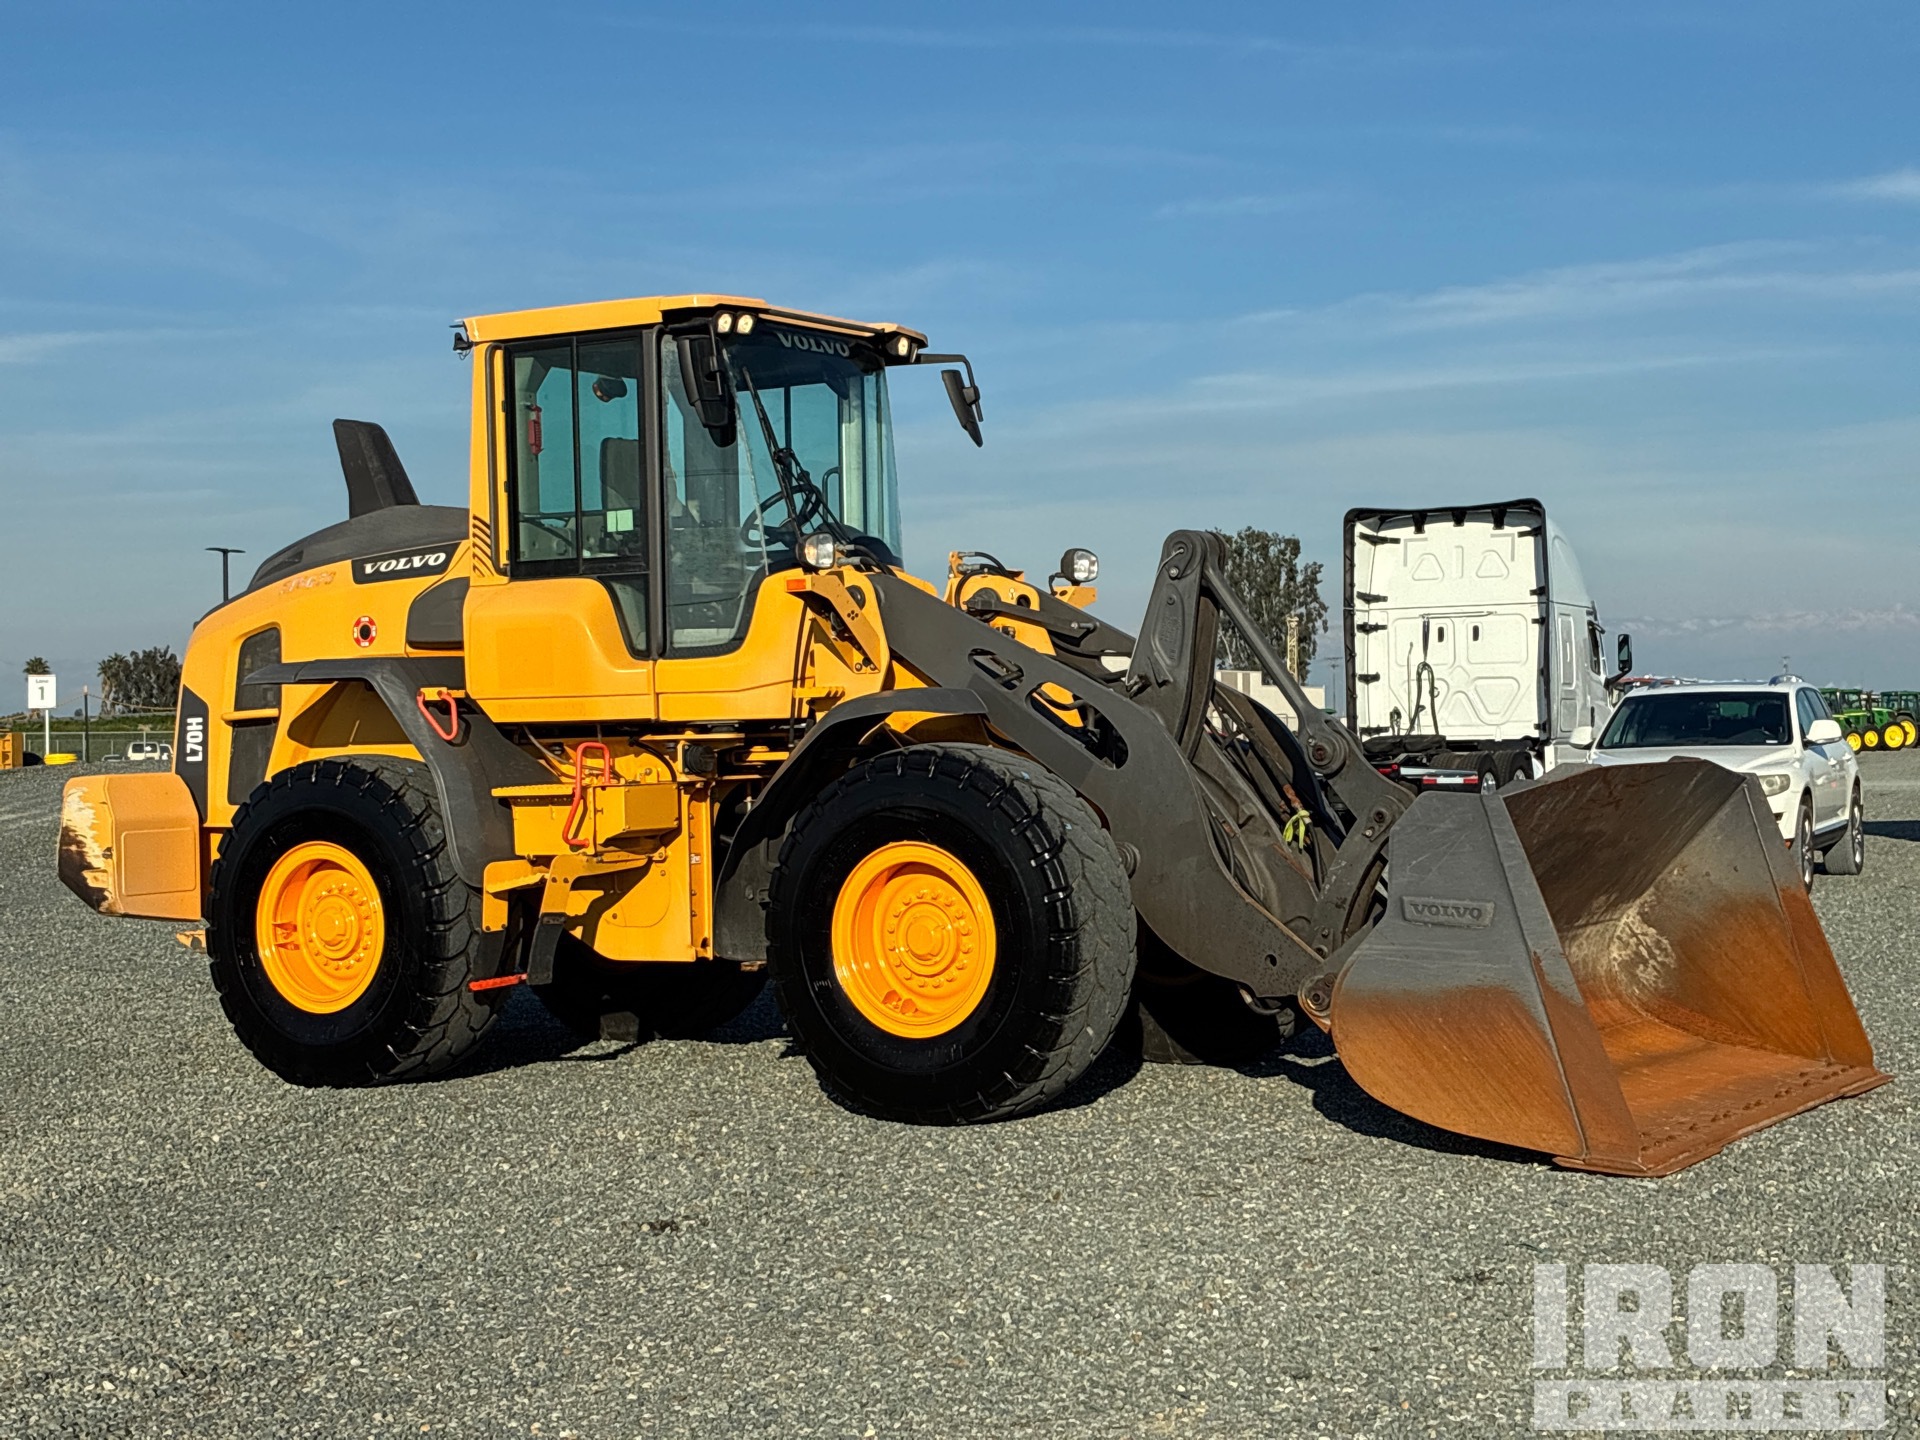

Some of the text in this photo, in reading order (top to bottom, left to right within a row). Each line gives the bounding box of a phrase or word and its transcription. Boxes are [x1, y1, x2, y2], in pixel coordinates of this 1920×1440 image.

[776, 332, 851, 357] VOLVO
[363, 552, 447, 575] VOLVO
[38, 686, 45, 700] 1
[186, 717, 203, 762] L70H
[1409, 903, 1482, 921] VOLVO
